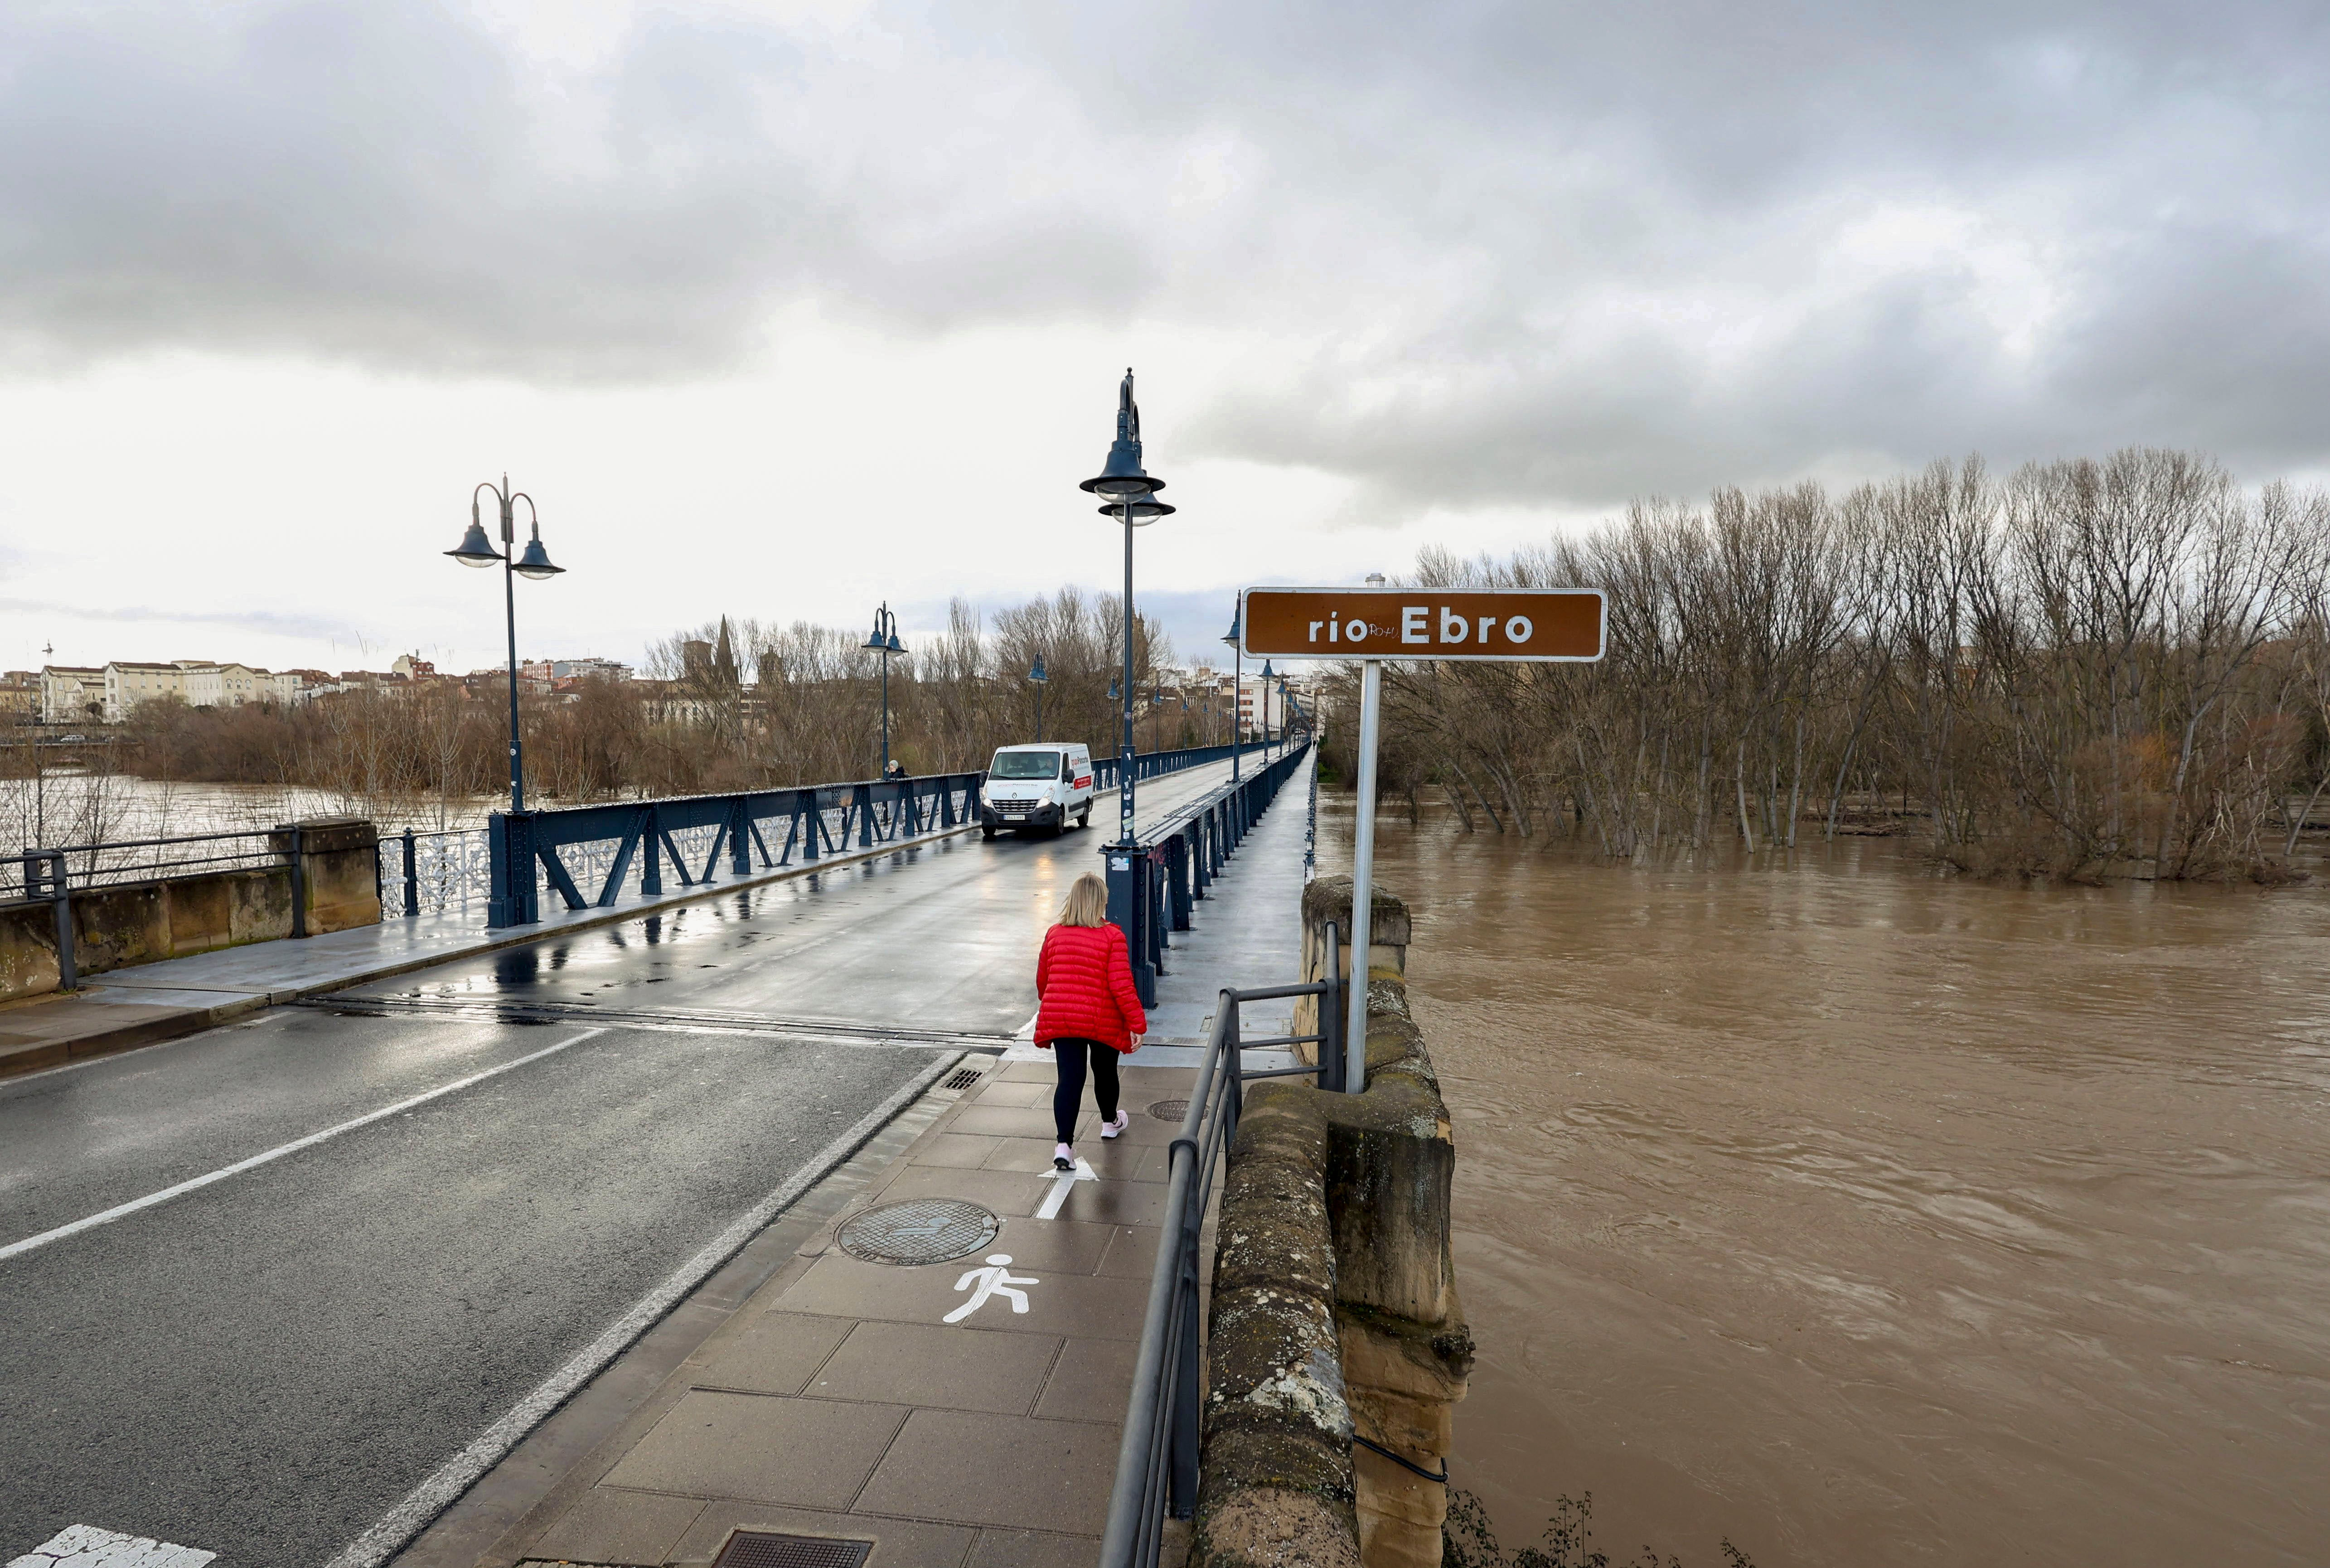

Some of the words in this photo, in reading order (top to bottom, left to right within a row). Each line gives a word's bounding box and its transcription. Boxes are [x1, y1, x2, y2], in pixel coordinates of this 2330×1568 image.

[1309, 611, 1367, 642] río
[1401, 607, 1533, 644] Ebro
[957, 1203, 988, 1220] RIOJA
